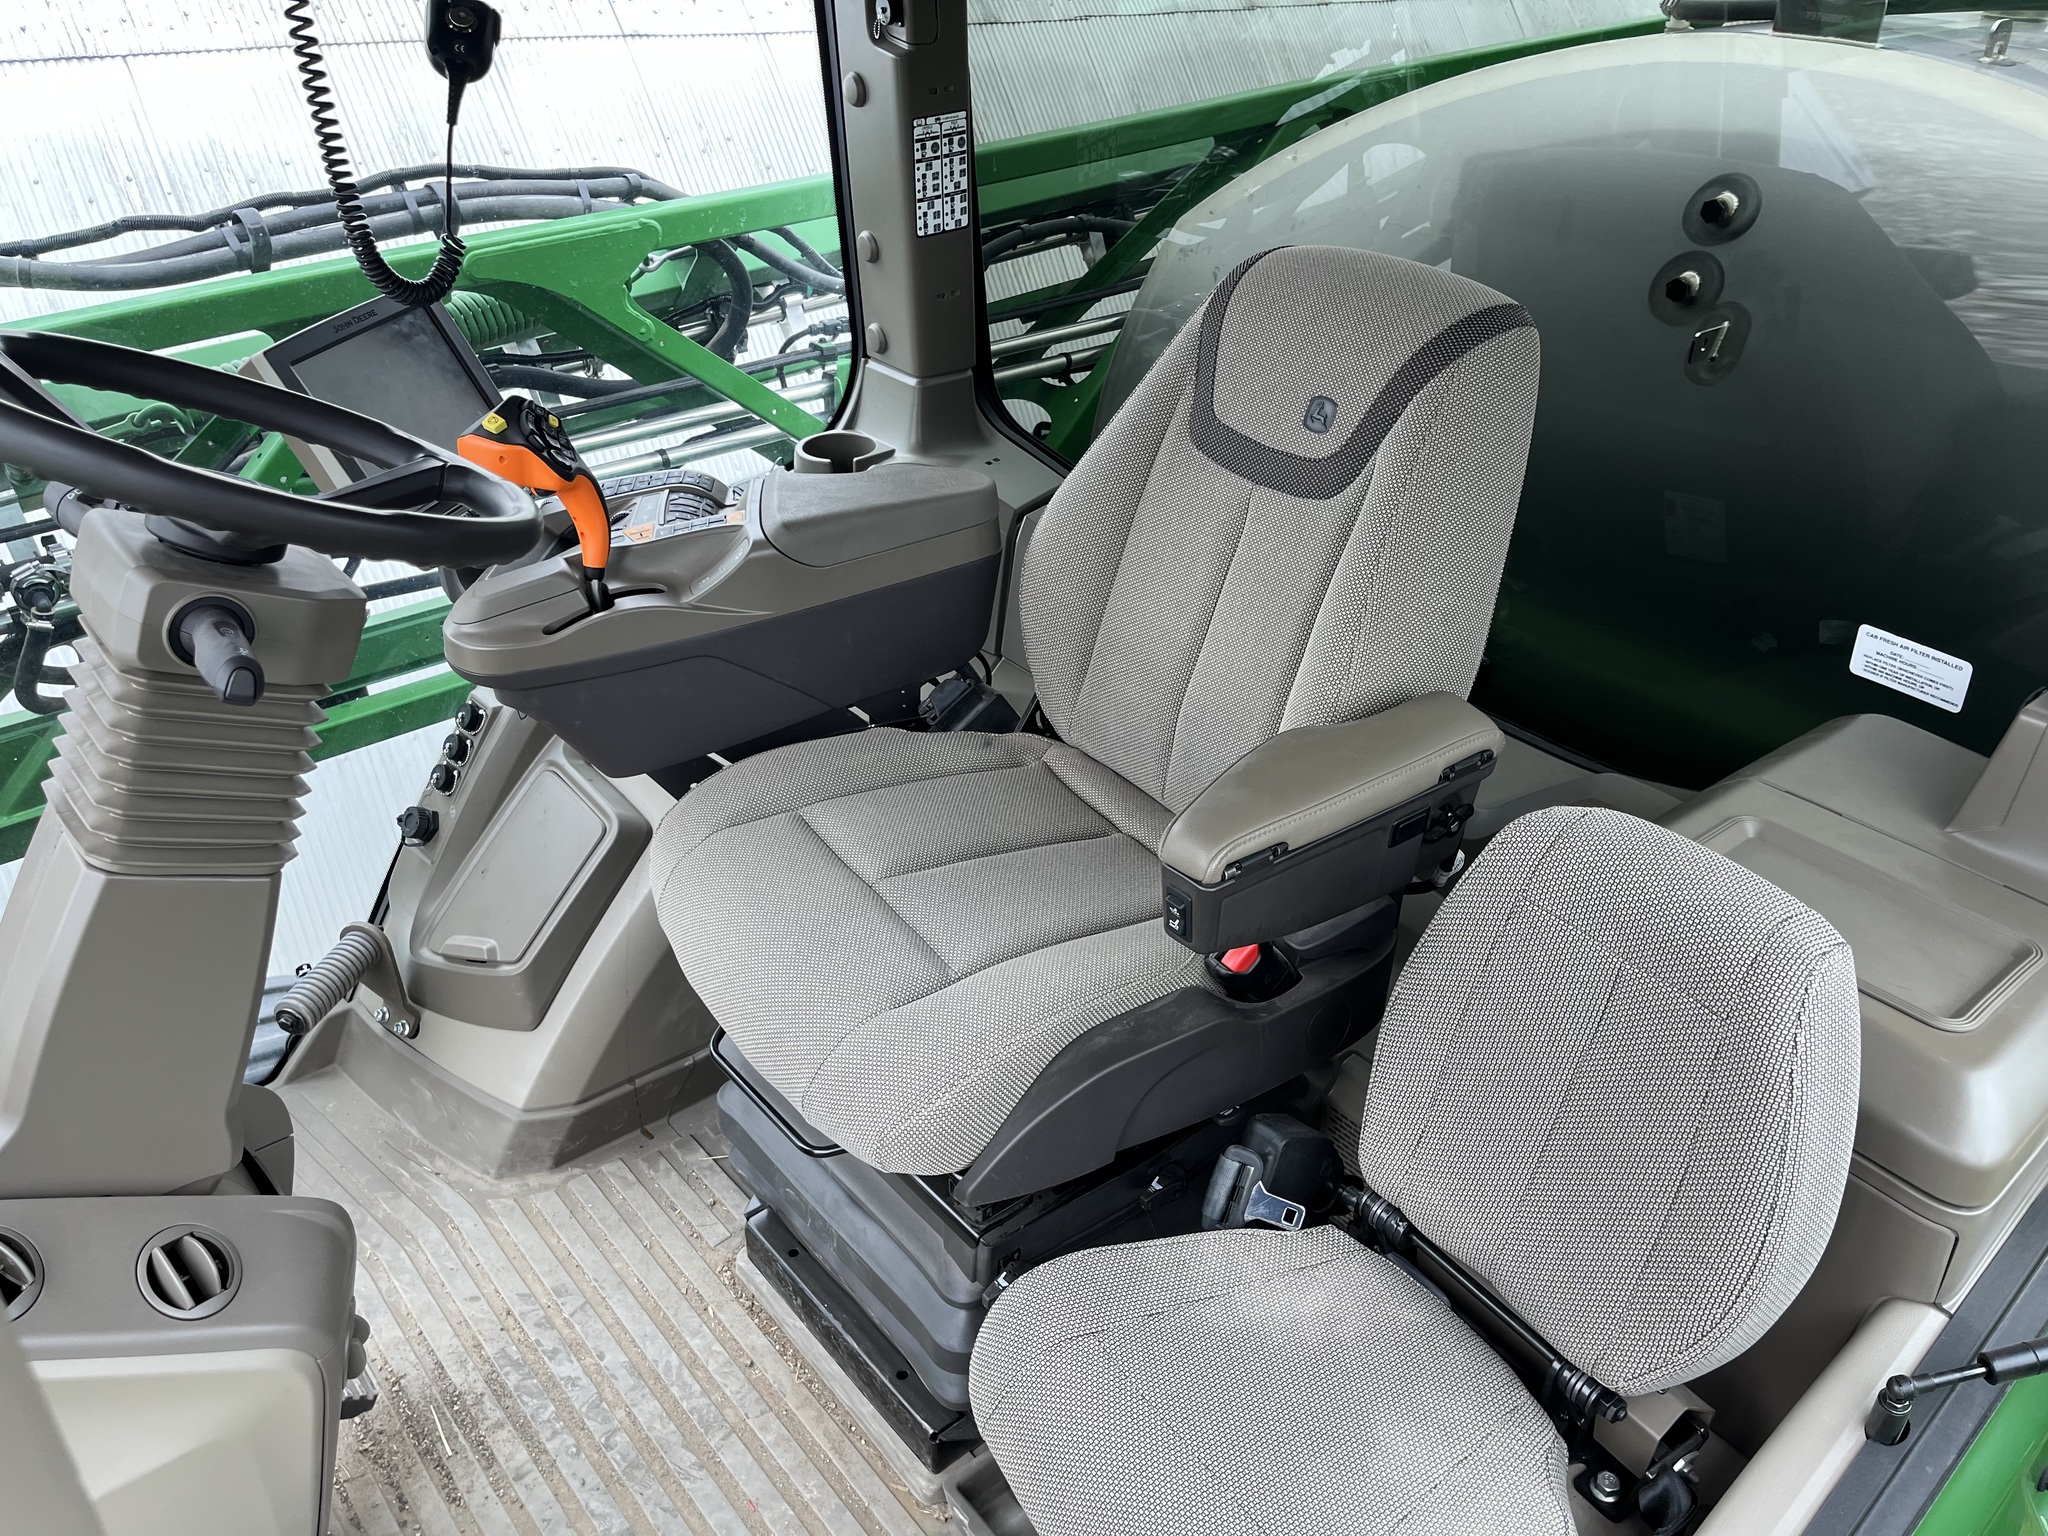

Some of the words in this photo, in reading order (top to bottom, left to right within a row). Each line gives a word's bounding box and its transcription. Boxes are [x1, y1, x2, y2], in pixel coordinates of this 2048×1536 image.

[333, 320, 353, 334] JOHN
[352, 309, 378, 324] DEERE
[1876, 651, 1898, 661] MACHINE
[1880, 637, 1899, 647] FRESH
[1911, 648, 1930, 659] FILTER
[1931, 656, 1964, 671] INSTALLED
